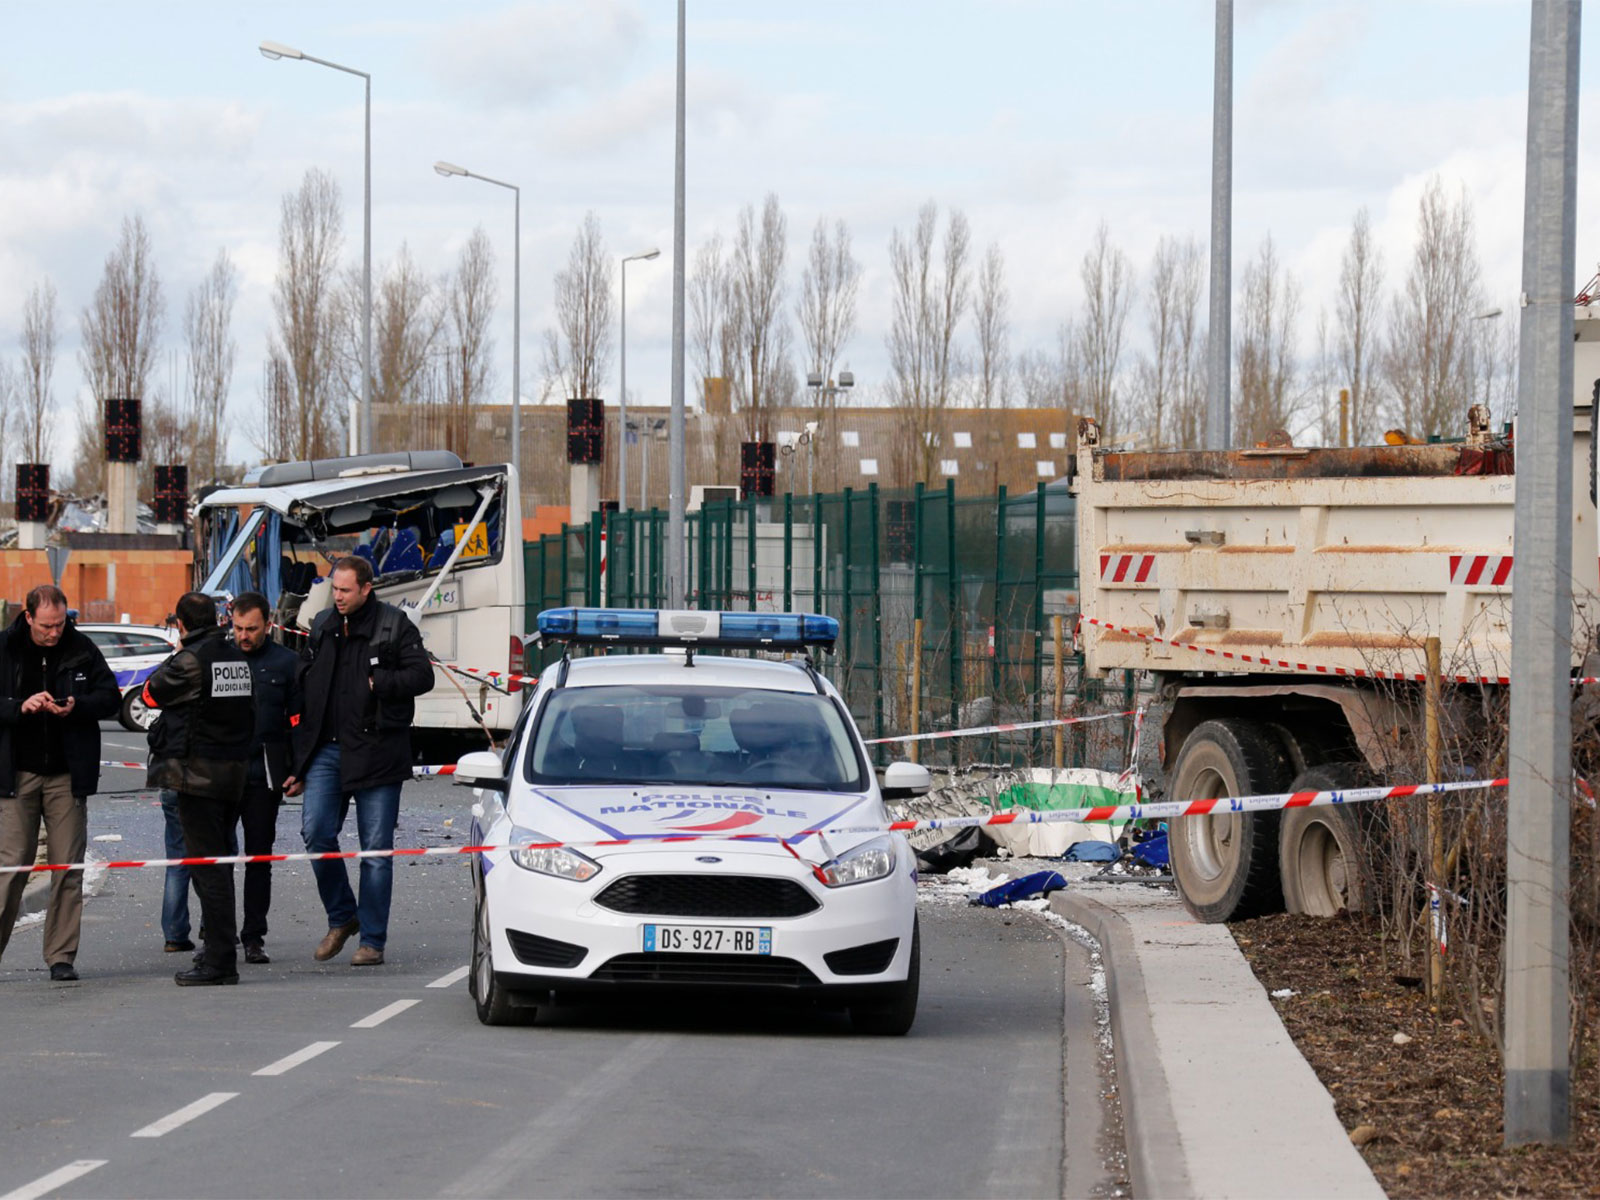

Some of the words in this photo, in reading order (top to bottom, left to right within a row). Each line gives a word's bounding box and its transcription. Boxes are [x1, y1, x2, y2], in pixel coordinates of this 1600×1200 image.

[214, 666, 250, 680] POLICE
[641, 794, 766, 805] POLICE
[600, 801, 808, 819] NATIONALE
[759, 942, 769, 952] 33
